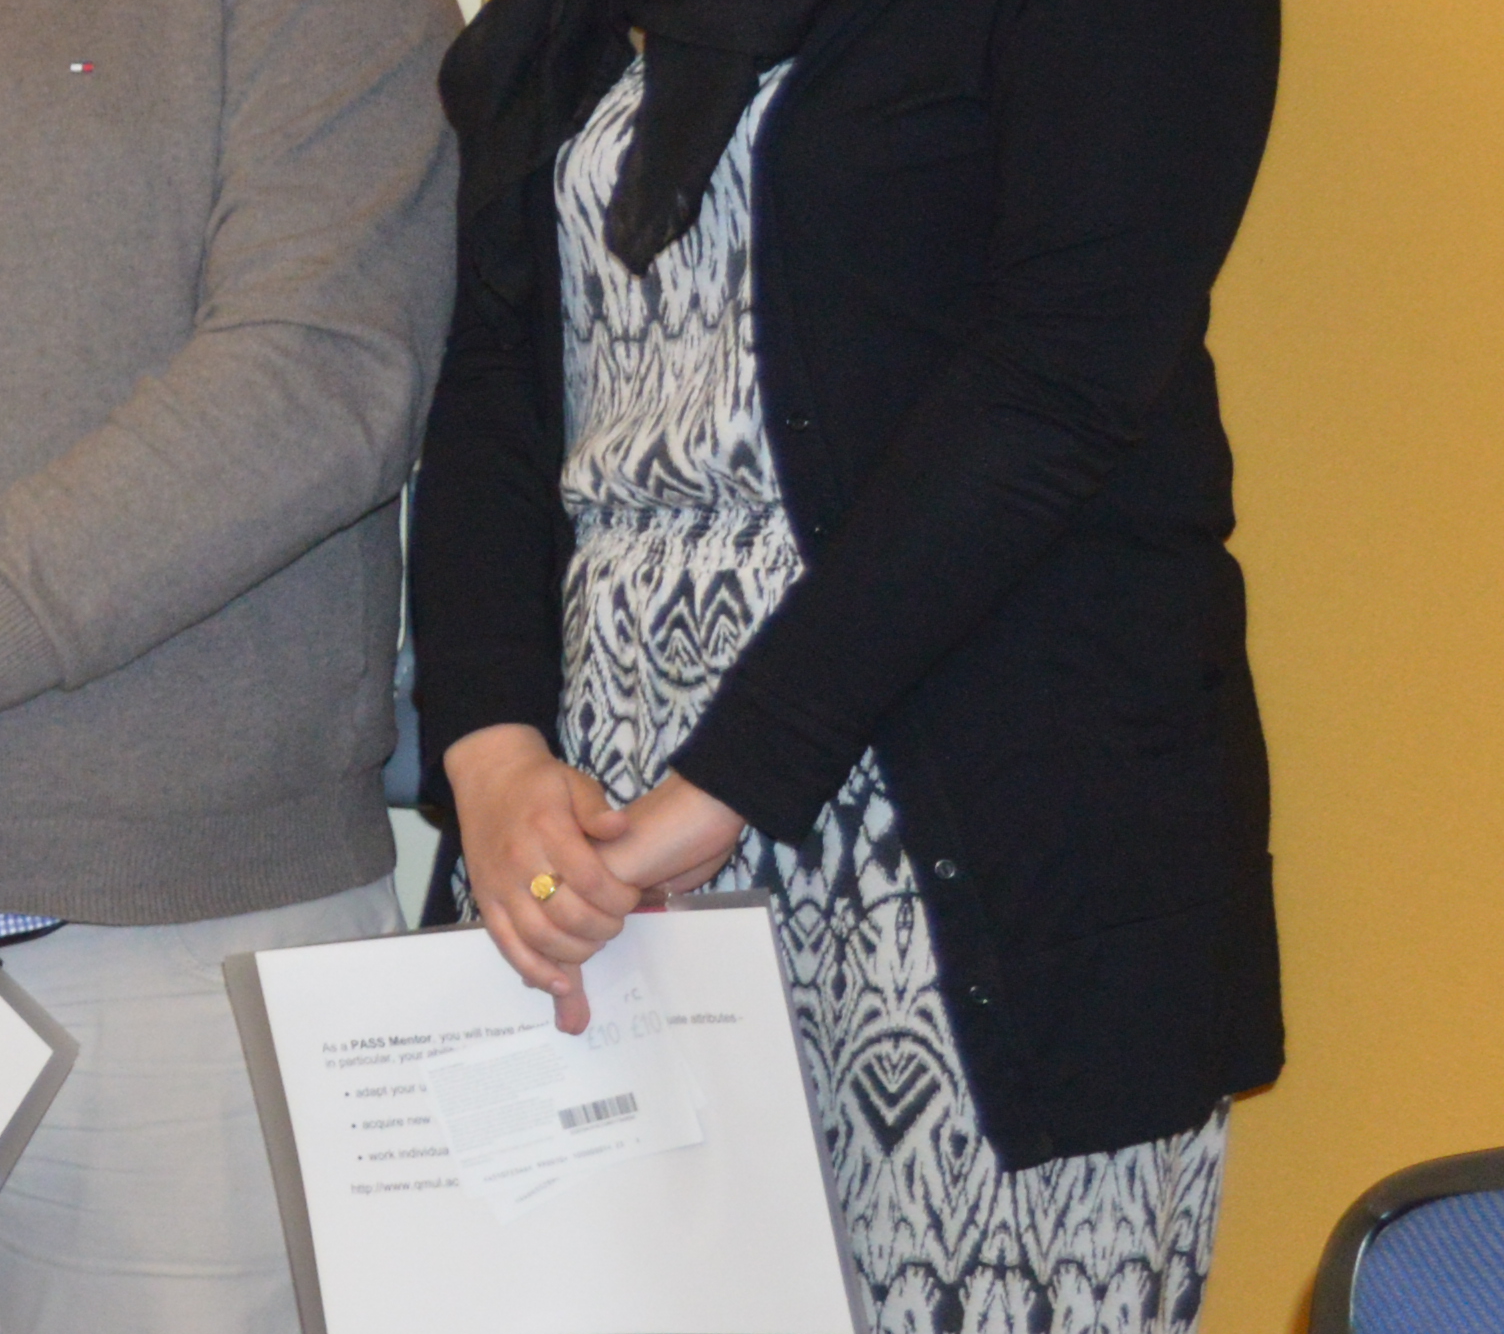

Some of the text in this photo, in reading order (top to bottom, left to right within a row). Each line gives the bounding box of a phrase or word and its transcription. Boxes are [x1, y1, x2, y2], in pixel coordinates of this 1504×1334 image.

[322, 1042, 340, 1054] As
[341, 1043, 348, 1052] a
[350, 1036, 386, 1051] PASS
[438, 1031, 460, 1045] you
[464, 1027, 483, 1039] will
[484, 1023, 515, 1038] have
[586, 1009, 663, 1051] £10 £10
[325, 1057, 336, 1069] in
[399, 1050, 423, 1064] your
[355, 1083, 416, 1099] adapt your
[362, 1114, 432, 1131] acquire new
[368, 1148, 395, 1161] work
